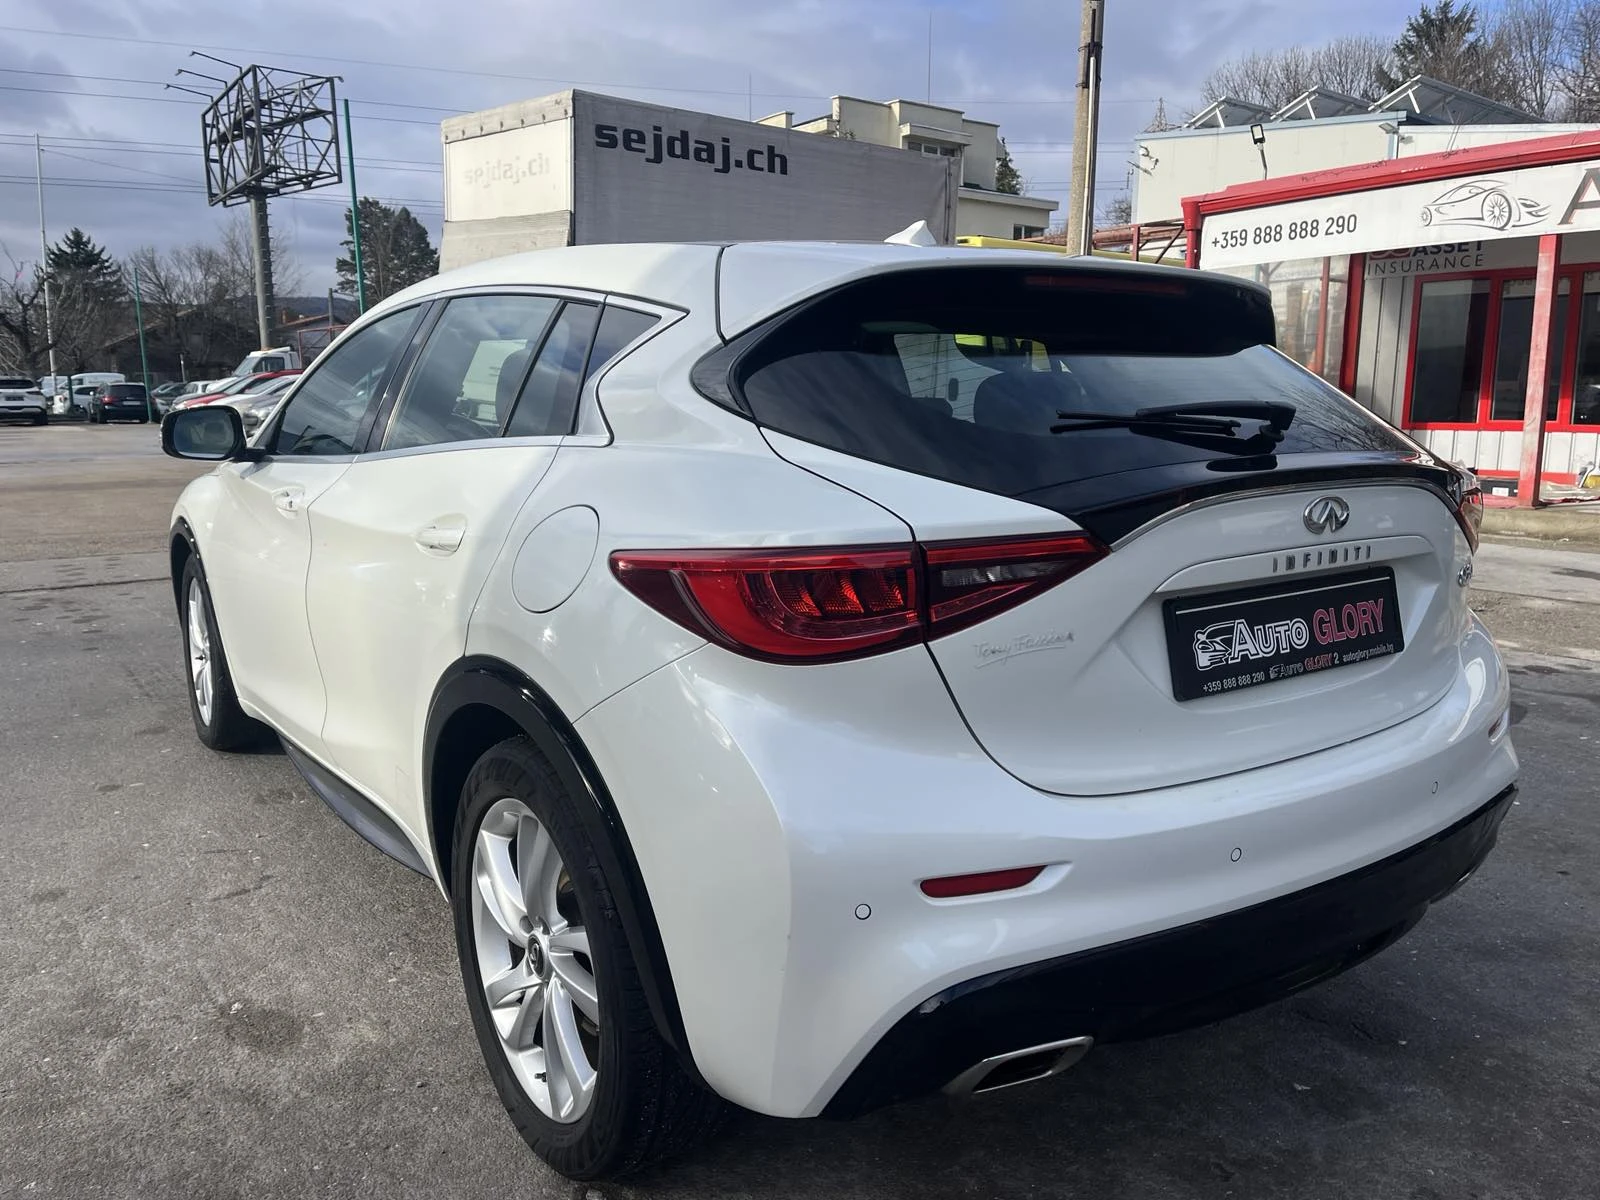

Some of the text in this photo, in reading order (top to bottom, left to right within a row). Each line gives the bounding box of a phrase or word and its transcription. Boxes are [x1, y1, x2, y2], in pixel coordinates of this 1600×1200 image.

[594, 122, 788, 175] sejdaj.ch
[1211, 214, 1357, 249] +359 888 888 290
[1367, 253, 1485, 276] INSURANCE
[1272, 545, 1371, 573] INFINITI
[1312, 598, 1384, 645] GLORY
[1202, 680, 1222, 693] +359
[1223, 677, 1237, 689] 888
[1238, 674, 1252, 686] 888
[1252, 671, 1265, 683] 290
[1304, 653, 1332, 671] GLORY
[1333, 652, 1340, 665] 2
